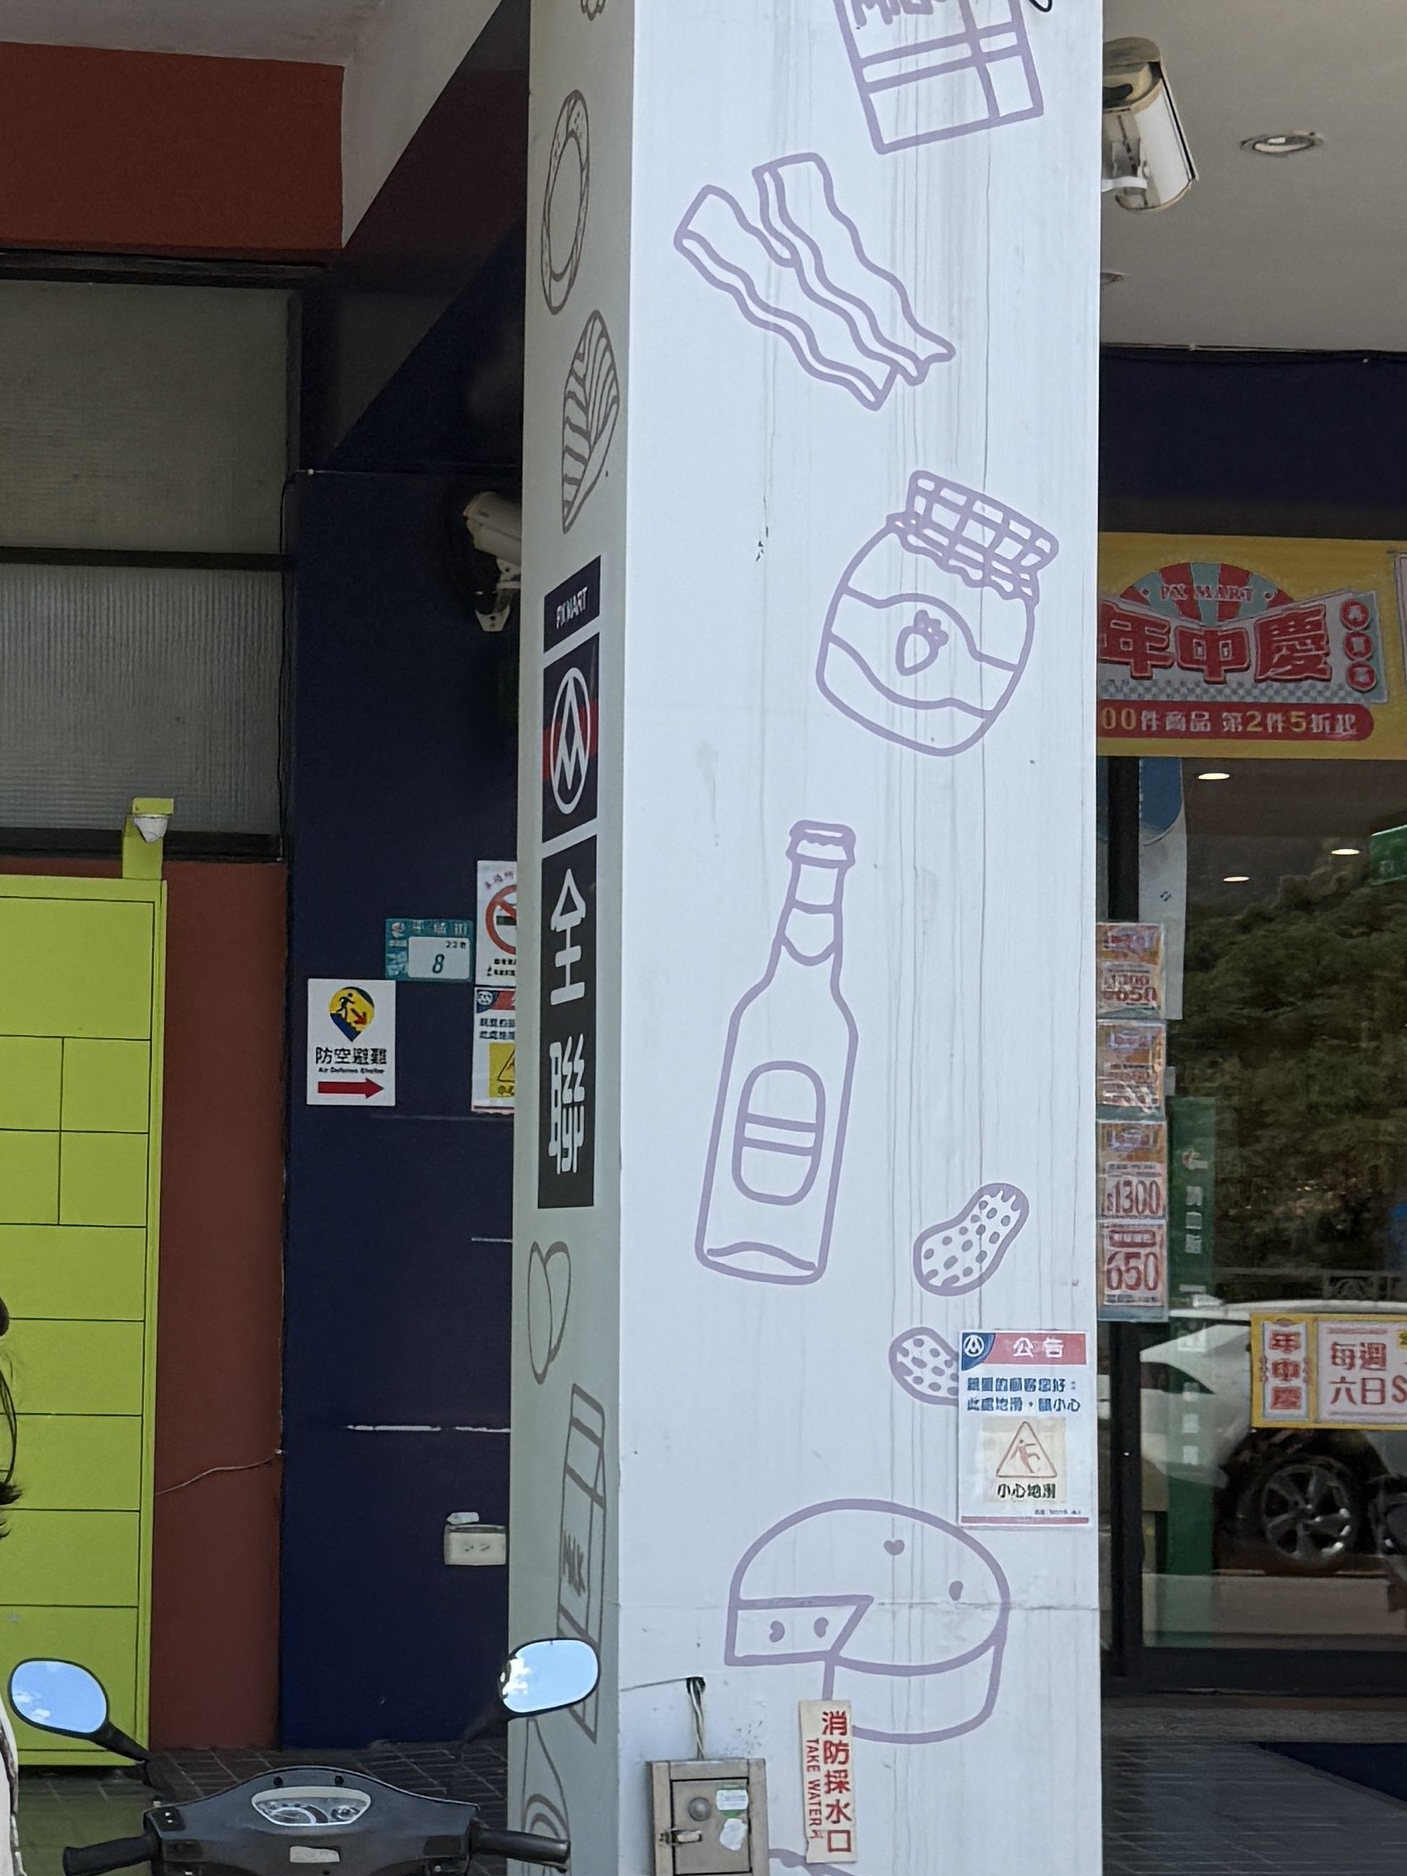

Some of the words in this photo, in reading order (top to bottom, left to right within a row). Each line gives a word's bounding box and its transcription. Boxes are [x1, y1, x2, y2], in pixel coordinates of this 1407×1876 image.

[1098, 600, 1333, 684] 年中慶
[432, 954, 445, 974] 8
[549, 868, 587, 1175] 全聯
[315, 1046, 387, 1065] 防空避難
[1106, 1252, 1159, 1291] 650
[1330, 1341, 1388, 1372] 每週
[1329, 1376, 1387, 1405] 六日
[806, 1738, 820, 1773] TAKE
[822, 1710, 852, 1853] 消防採水口
